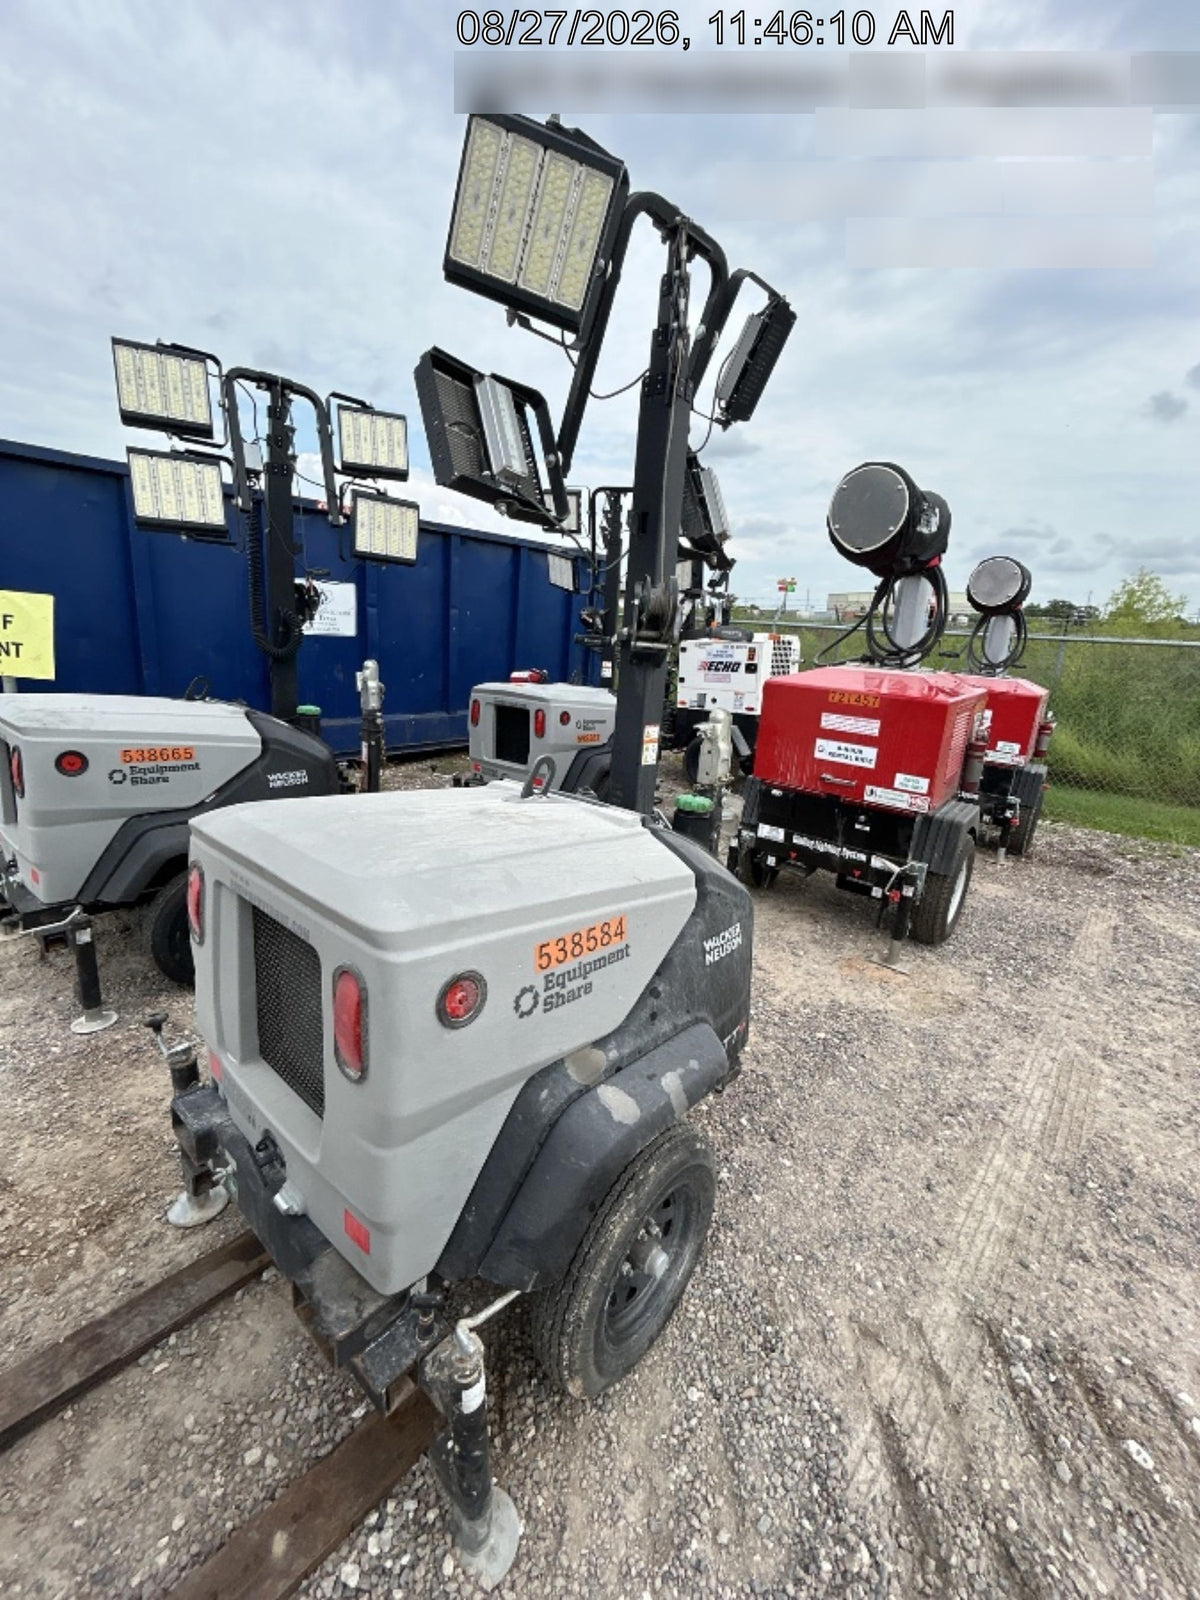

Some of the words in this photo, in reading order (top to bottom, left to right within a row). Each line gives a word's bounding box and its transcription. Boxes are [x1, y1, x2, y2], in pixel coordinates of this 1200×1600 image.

[707, 660, 742, 673] ECHO
[122, 749, 194, 764] 538665
[129, 762, 201, 775] Equipment
[130, 775, 170, 786] Share
[538, 916, 626, 970] 538584
[703, 922, 741, 952] WACKER
[705, 932, 742, 966] NEUSON
[543, 943, 631, 992] Equipment
[543, 980, 593, 1014] Share
